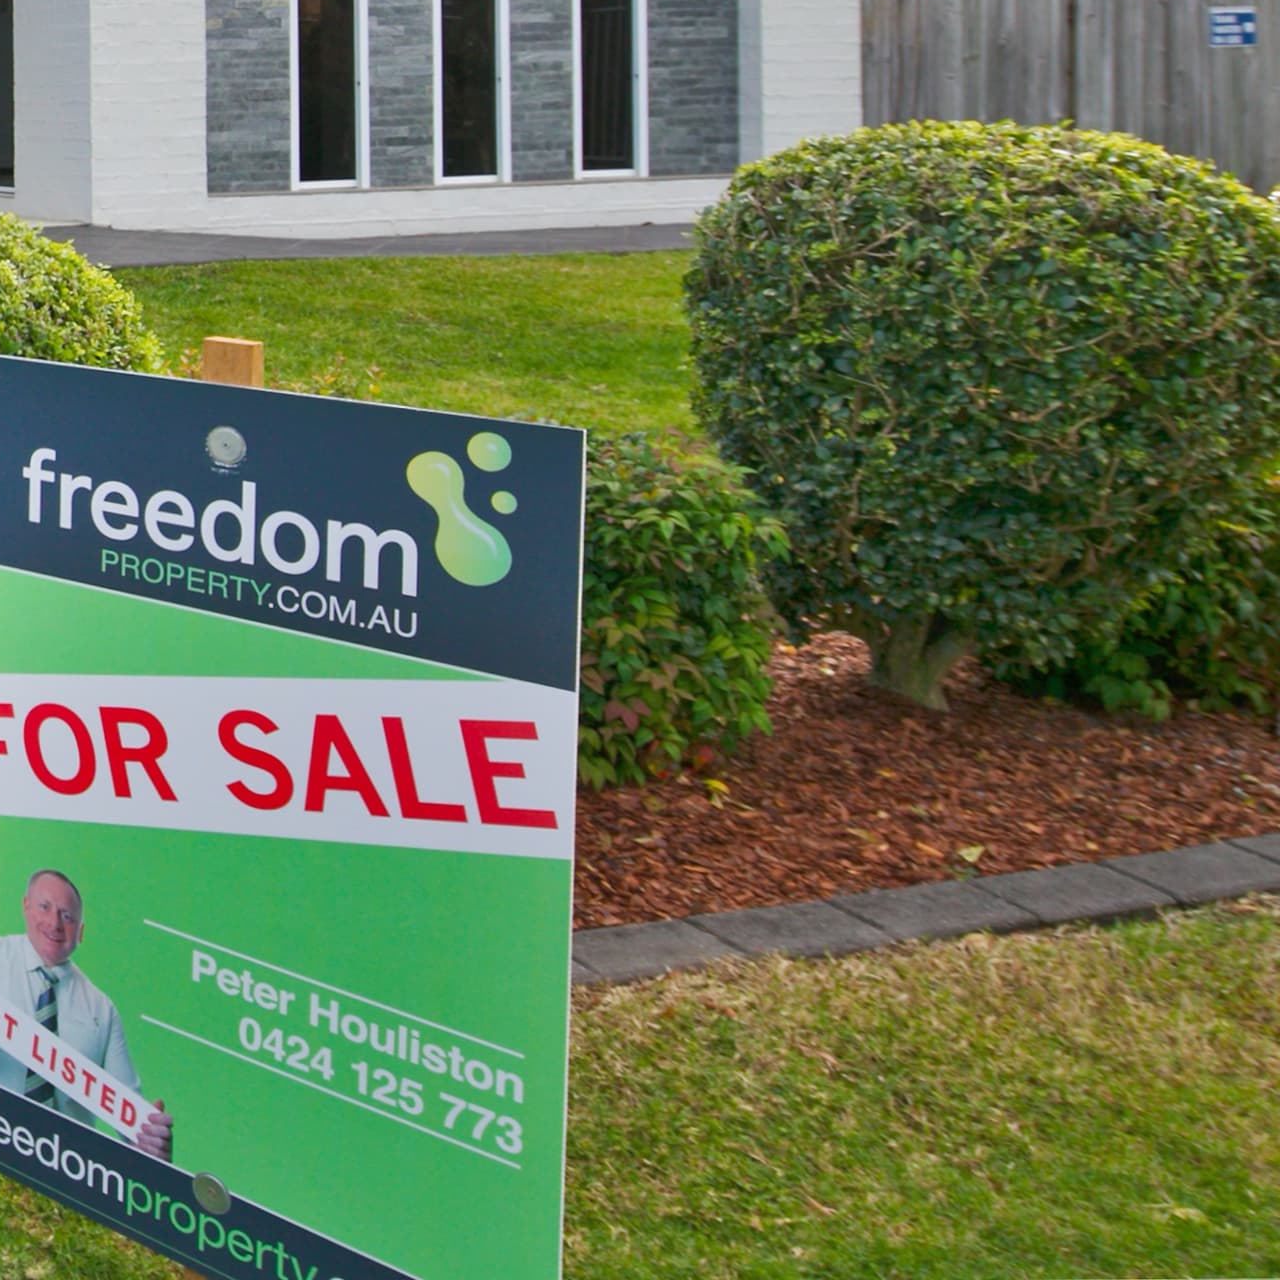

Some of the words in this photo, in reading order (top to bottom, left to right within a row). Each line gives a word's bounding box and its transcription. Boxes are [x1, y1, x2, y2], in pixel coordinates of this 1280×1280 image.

[22, 448, 418, 597] freedom
[100, 549, 418, 639] PROPERTY.COM.AU
[217, 709, 559, 829] SALE
[31, 1034, 138, 1128] LISTED
[191, 949, 295, 1016] Peter
[308, 993, 525, 1104] Houliston
[238, 1017, 335, 1081] 0424
[351, 1061, 424, 1116] 125
[439, 1092, 524, 1155] 773
